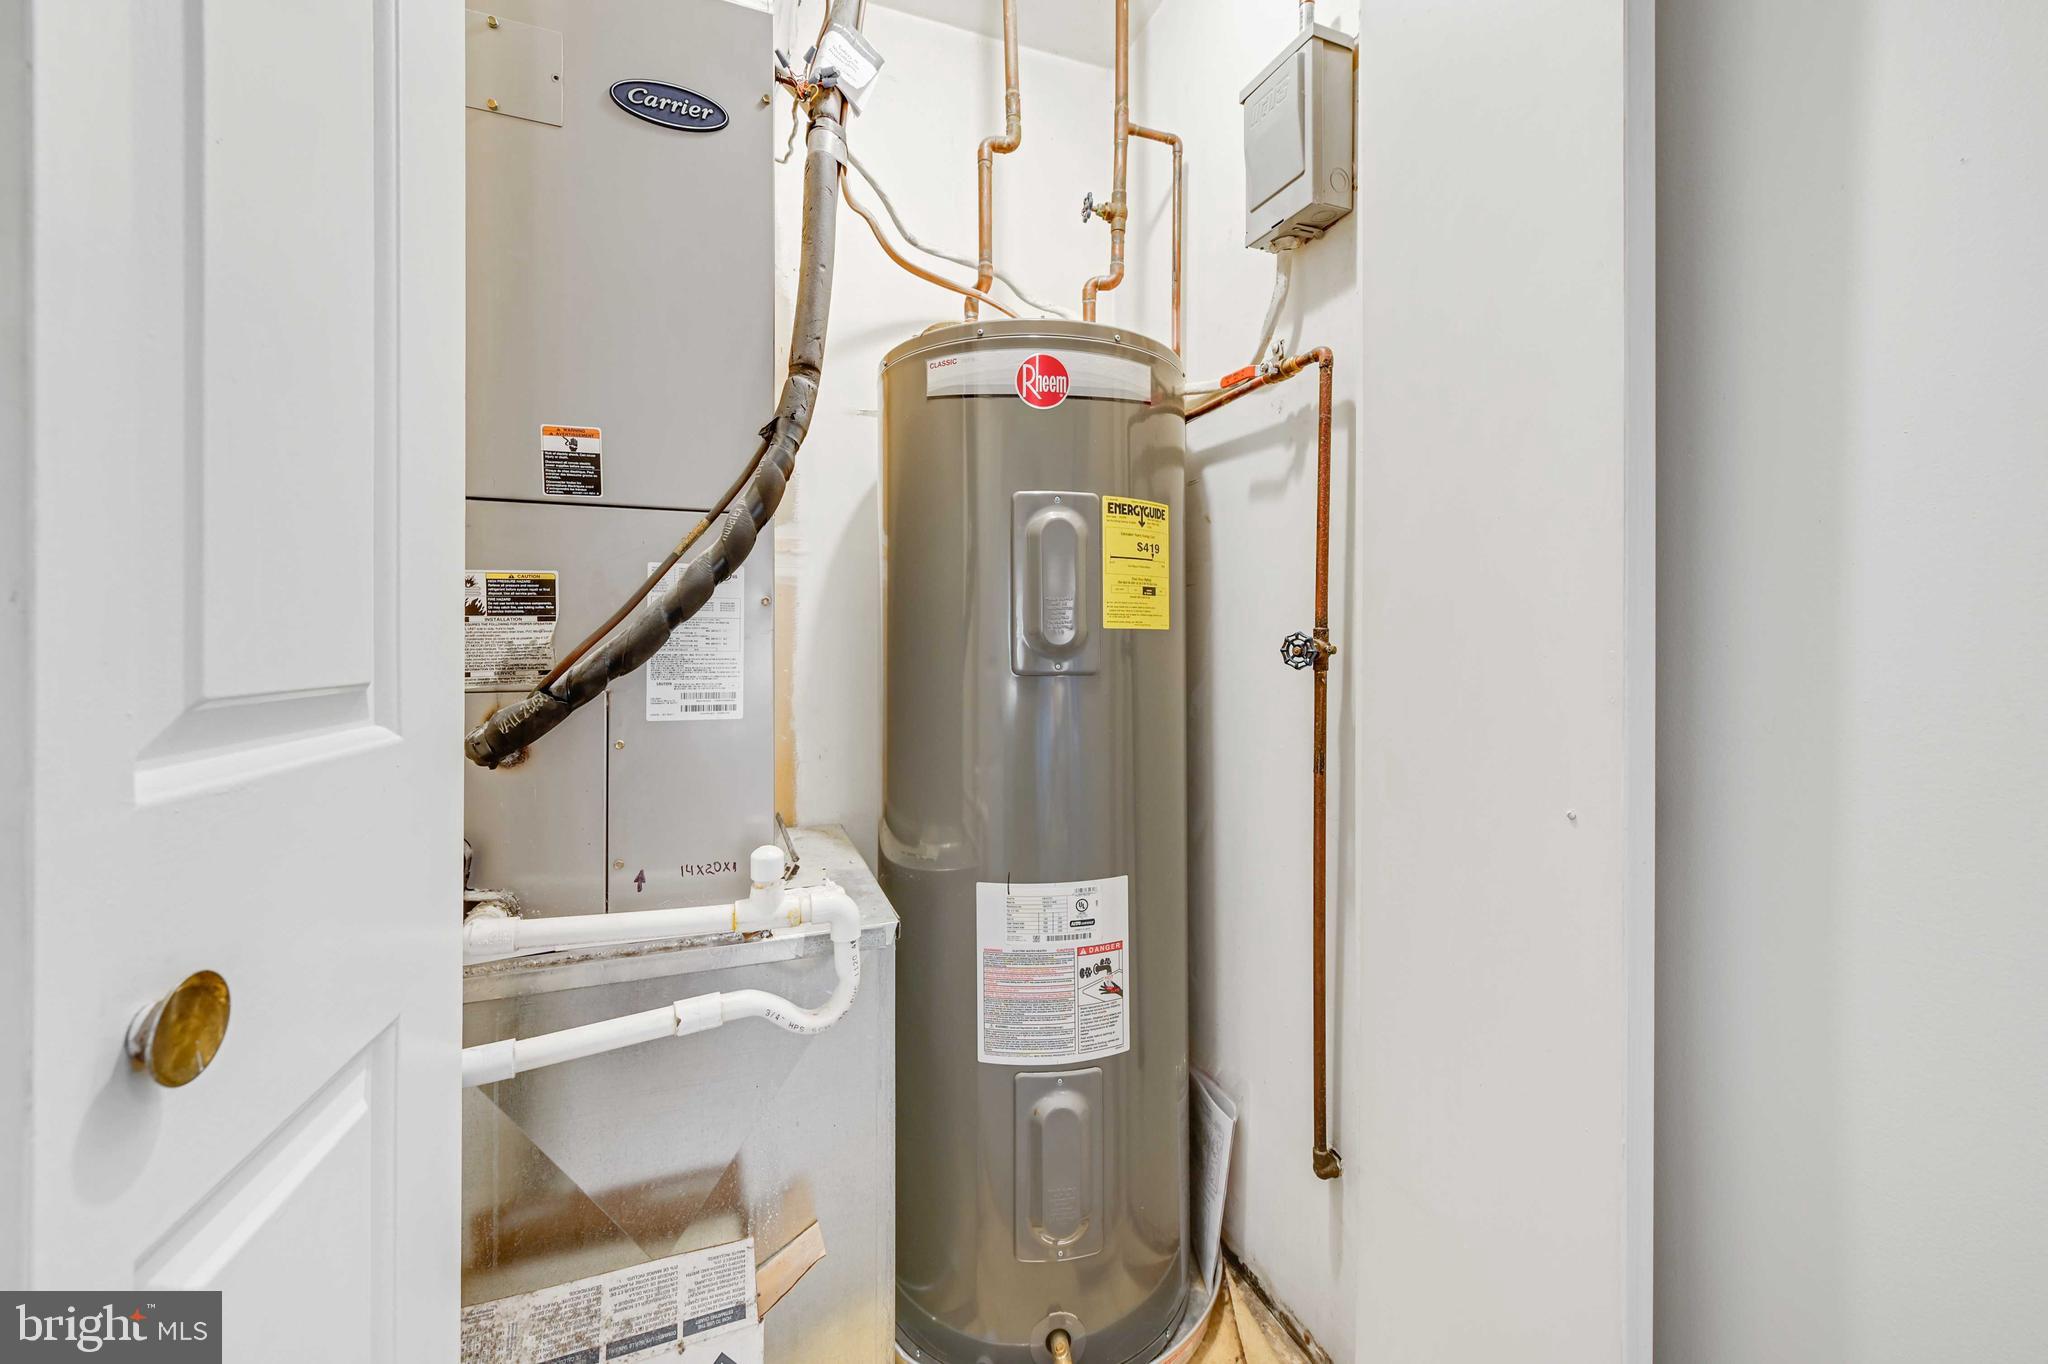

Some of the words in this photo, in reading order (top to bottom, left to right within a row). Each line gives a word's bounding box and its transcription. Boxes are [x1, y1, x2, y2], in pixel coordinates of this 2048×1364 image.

[628, 88, 713, 119] Carrier
[930, 359, 957, 369] CLASSIC
[1022, 353, 1067, 400] Rheem
[1108, 502, 1165, 520] ENERGYGUIDE
[1089, 943, 1121, 954] DANGER
